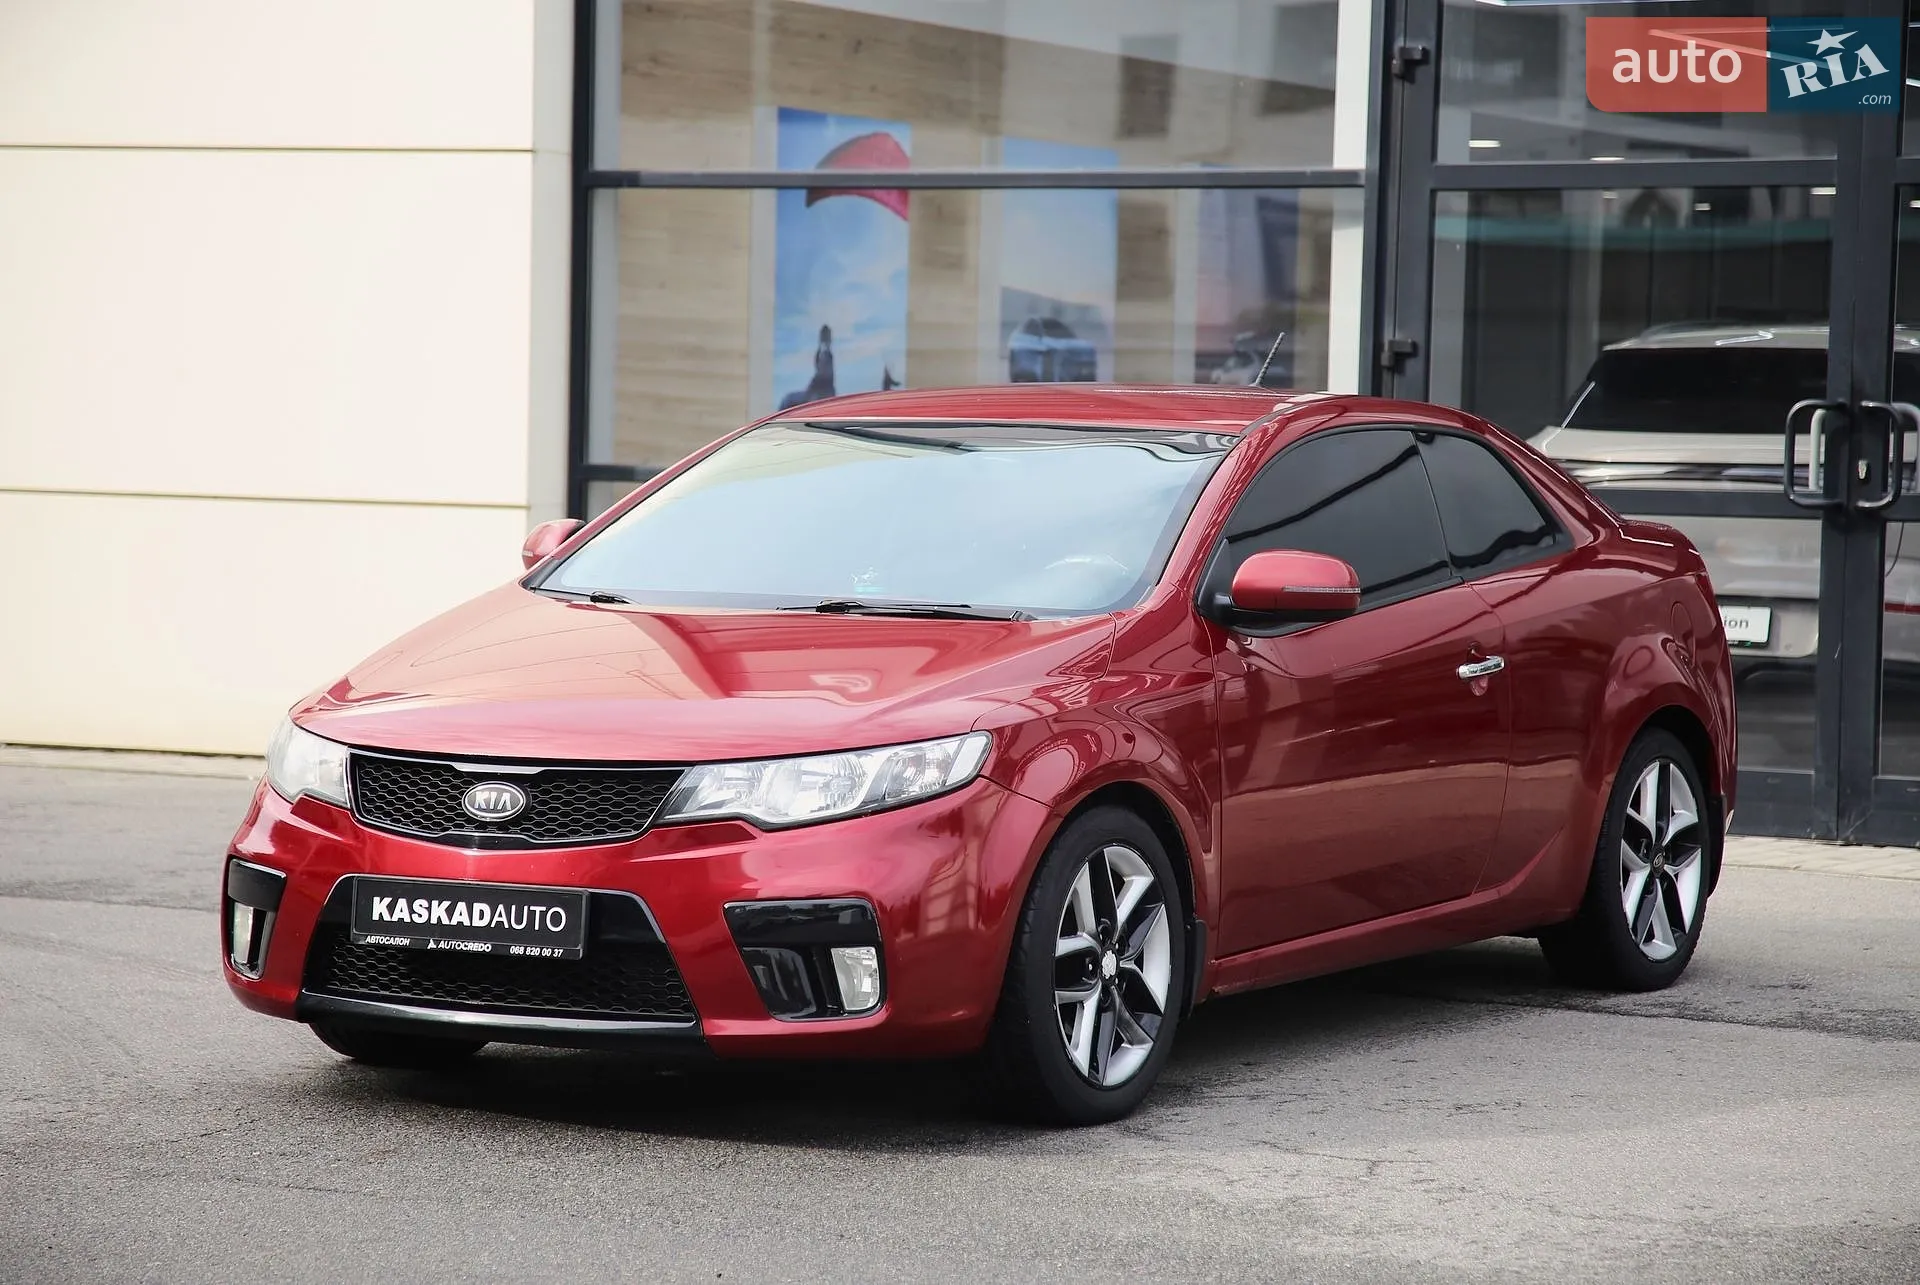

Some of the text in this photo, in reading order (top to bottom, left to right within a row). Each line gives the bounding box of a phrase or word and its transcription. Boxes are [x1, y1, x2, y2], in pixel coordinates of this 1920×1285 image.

[1723, 616, 1749, 629] ion
[474, 791, 512, 811] KIA
[371, 896, 567, 932] KASKADAUTO
[365, 935, 411, 946] АВТОСАЛОН
[437, 940, 492, 952] AUTOCREDO
[509, 945, 563, 957] 068 820 00 37
